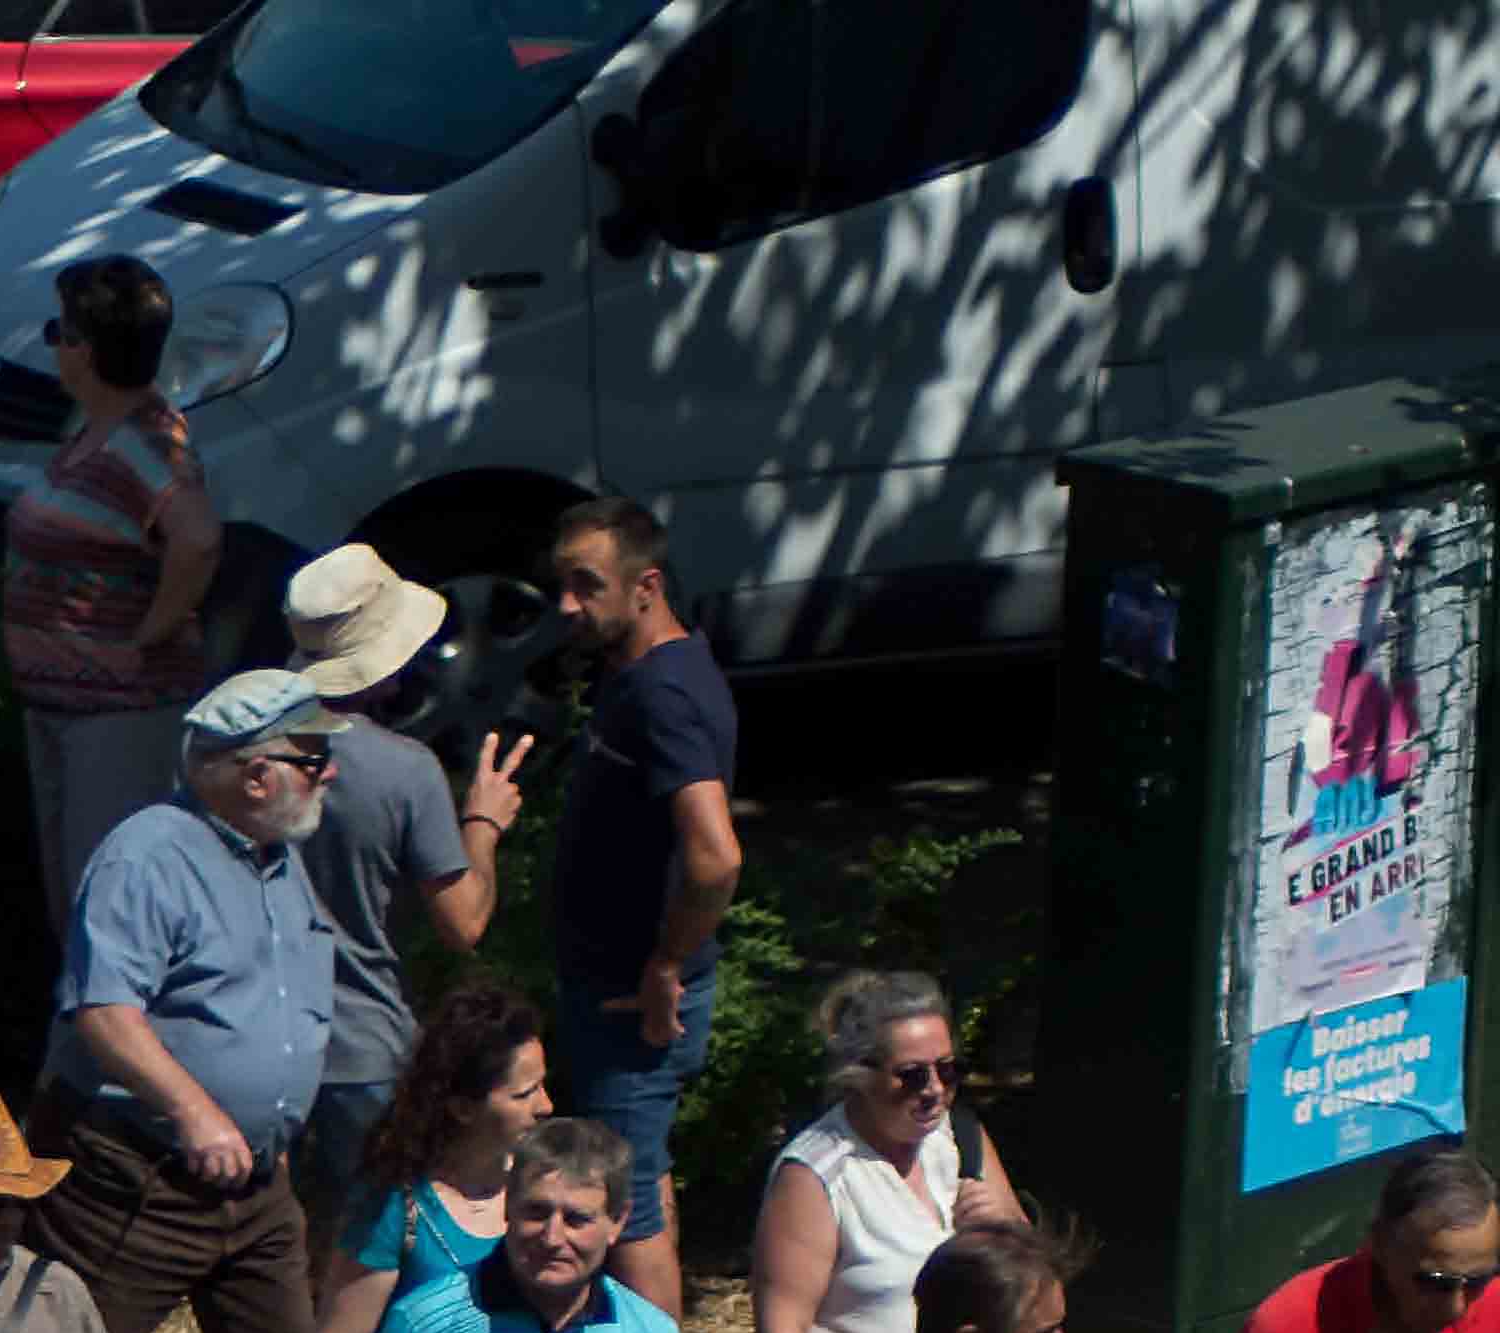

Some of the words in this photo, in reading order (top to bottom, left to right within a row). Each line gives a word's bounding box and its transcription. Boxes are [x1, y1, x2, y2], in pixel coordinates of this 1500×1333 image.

[1311, 827, 1395, 892] GRAND
[1328, 881, 1360, 924] EN
[1311, 1009, 1410, 1059] Baisser
[1283, 1066, 1322, 1097] les
[1323, 1034, 1432, 1091] factures
